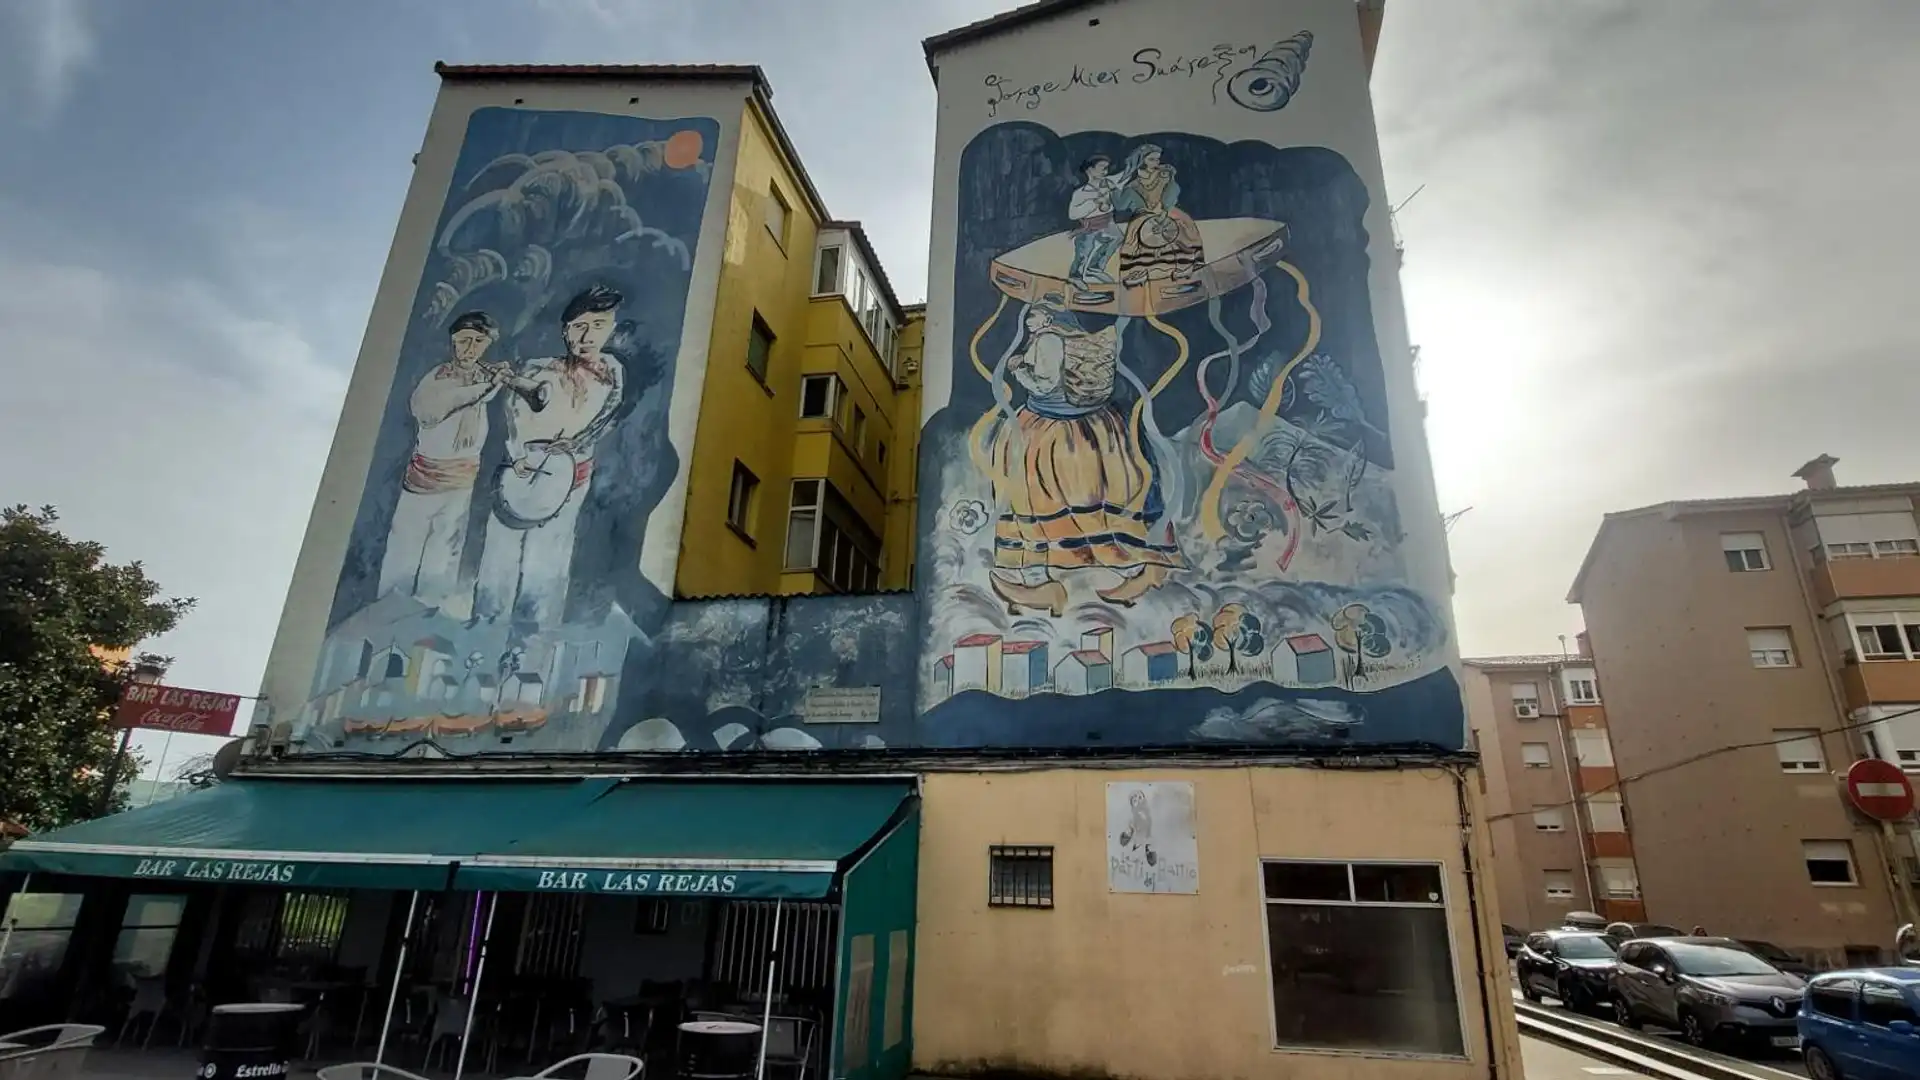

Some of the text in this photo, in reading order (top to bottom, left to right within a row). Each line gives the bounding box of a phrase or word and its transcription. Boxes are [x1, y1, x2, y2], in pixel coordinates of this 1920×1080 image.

[126, 685, 236, 712] BAR LAS REJAS
[133, 859, 294, 882] BAR LAS REJAS
[536, 871, 737, 893] BAR LAS REJAS
[235, 1063, 282, 1078] Estrella
